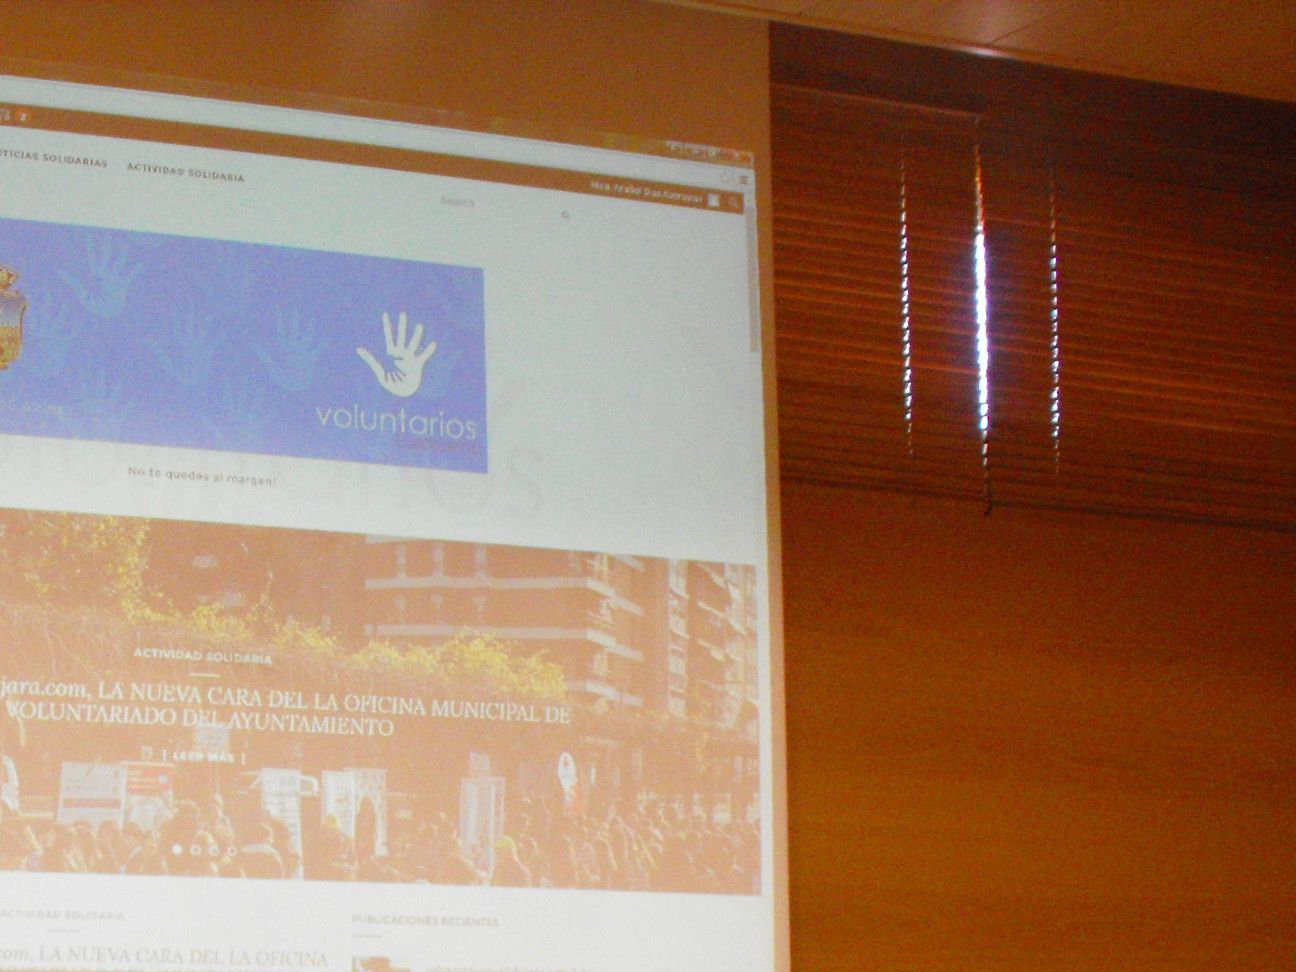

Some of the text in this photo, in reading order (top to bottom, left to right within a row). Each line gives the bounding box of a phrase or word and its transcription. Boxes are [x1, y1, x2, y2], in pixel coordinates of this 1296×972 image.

[42, 152, 108, 168] SOLIDARIAS
[126, 161, 245, 182] ACTIVIDAD SOLIDARIA
[315, 402, 478, 441] voluntarios
[127, 466, 146, 478] No
[149, 467, 161, 479] te
[164, 469, 210, 483] quedas
[213, 472, 224, 483] al
[133, 647, 273, 665] ACTIVIDAD SOLIDARIA
[97, 680, 124, 700] LA
[130, 681, 202, 703] NUEVA
[207, 685, 262, 707] CARA
[268, 688, 309, 710] DEL
[313, 691, 338, 711] LA
[343, 694, 426, 717] OFICINA
[431, 698, 539, 722] MUNICIPAL
[545, 704, 572, 724] DE
[6, 699, 395, 736] VOLUNTARIADO DEL AYUNTAMIENTO
[351, 913, 439, 927] PUBLICACIONES
[38, 945, 62, 962] LA
[67, 946, 130, 963] NUEVA
[134, 948, 185, 965] CARA
[189, 949, 225, 966] DEL
[229, 950, 252, 967] LA
[255, 950, 330, 968] OFICINA
